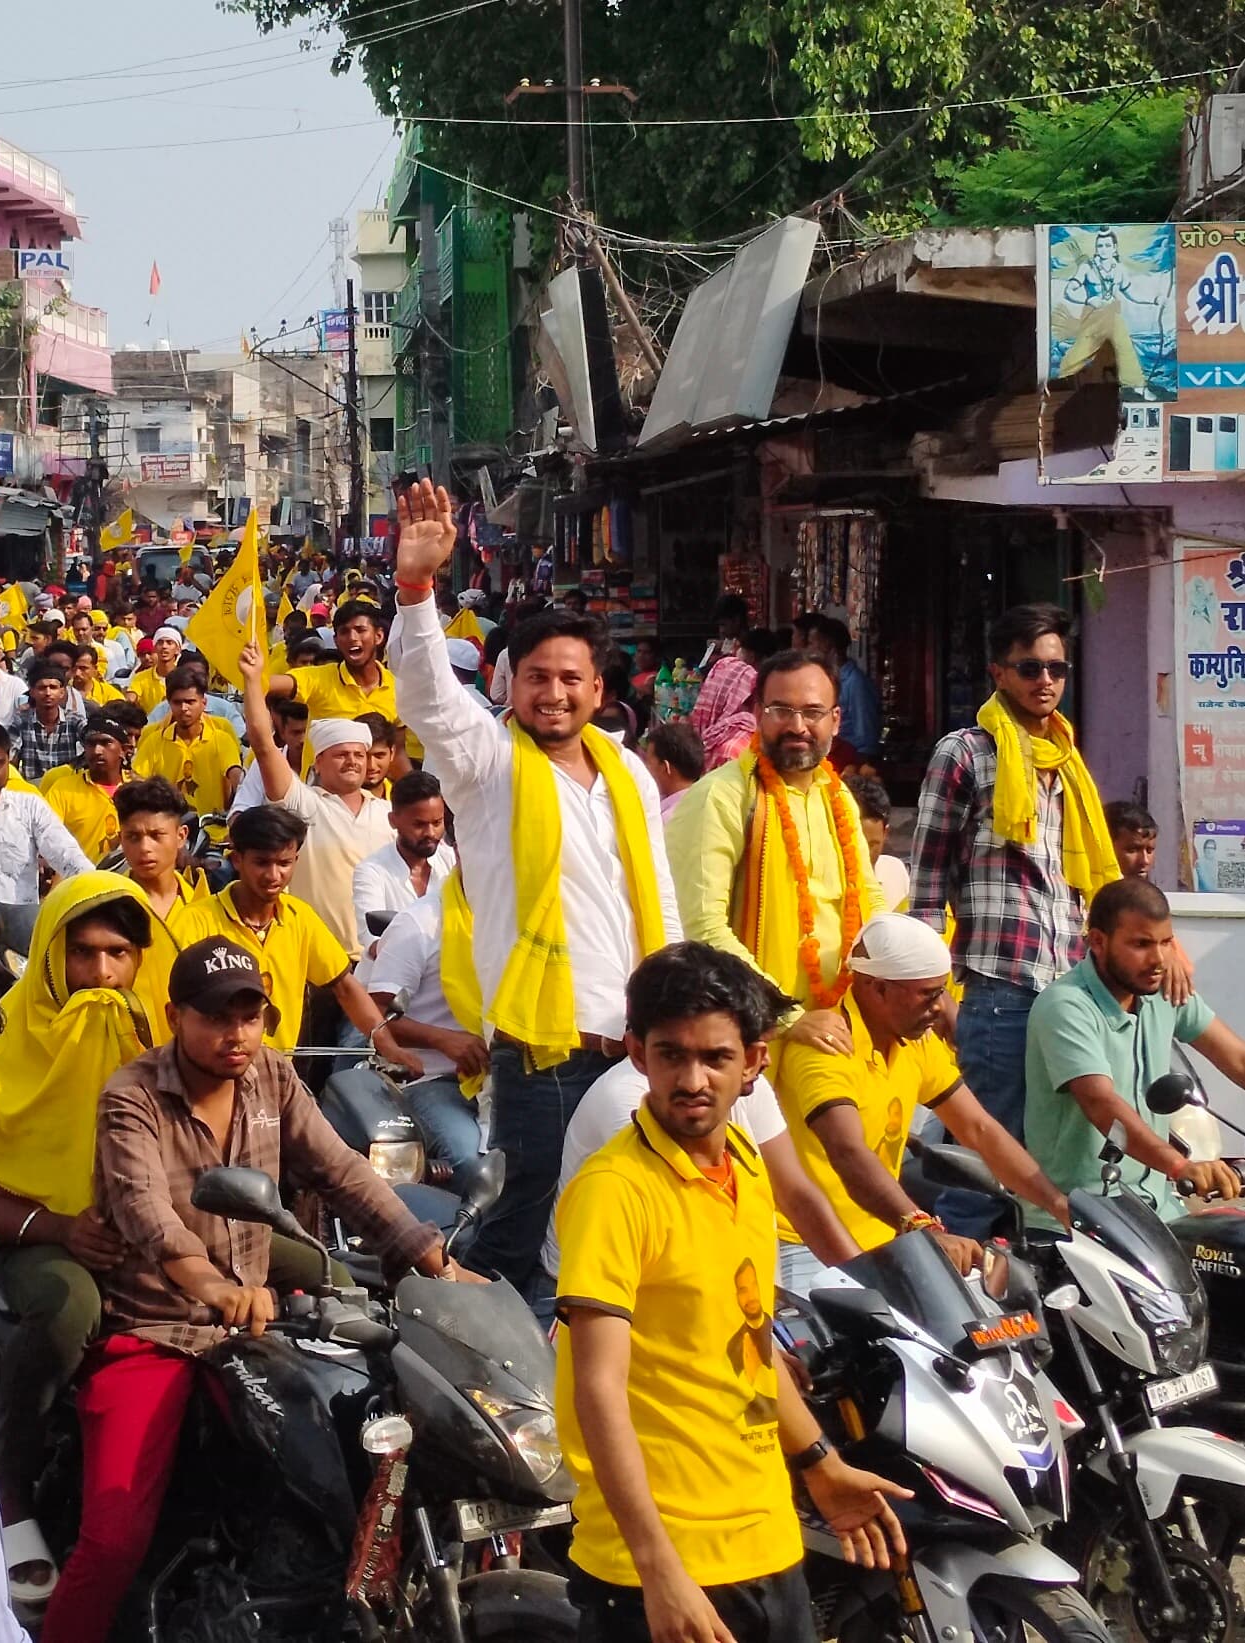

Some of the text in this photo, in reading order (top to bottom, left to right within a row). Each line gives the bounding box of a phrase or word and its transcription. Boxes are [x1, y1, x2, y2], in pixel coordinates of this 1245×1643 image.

[21, 252, 70, 270] PAL
[205, 947, 253, 974] KING
[1195, 1244, 1235, 1264] ROYAL
[1191, 1258, 1241, 1278] ENFIELD
